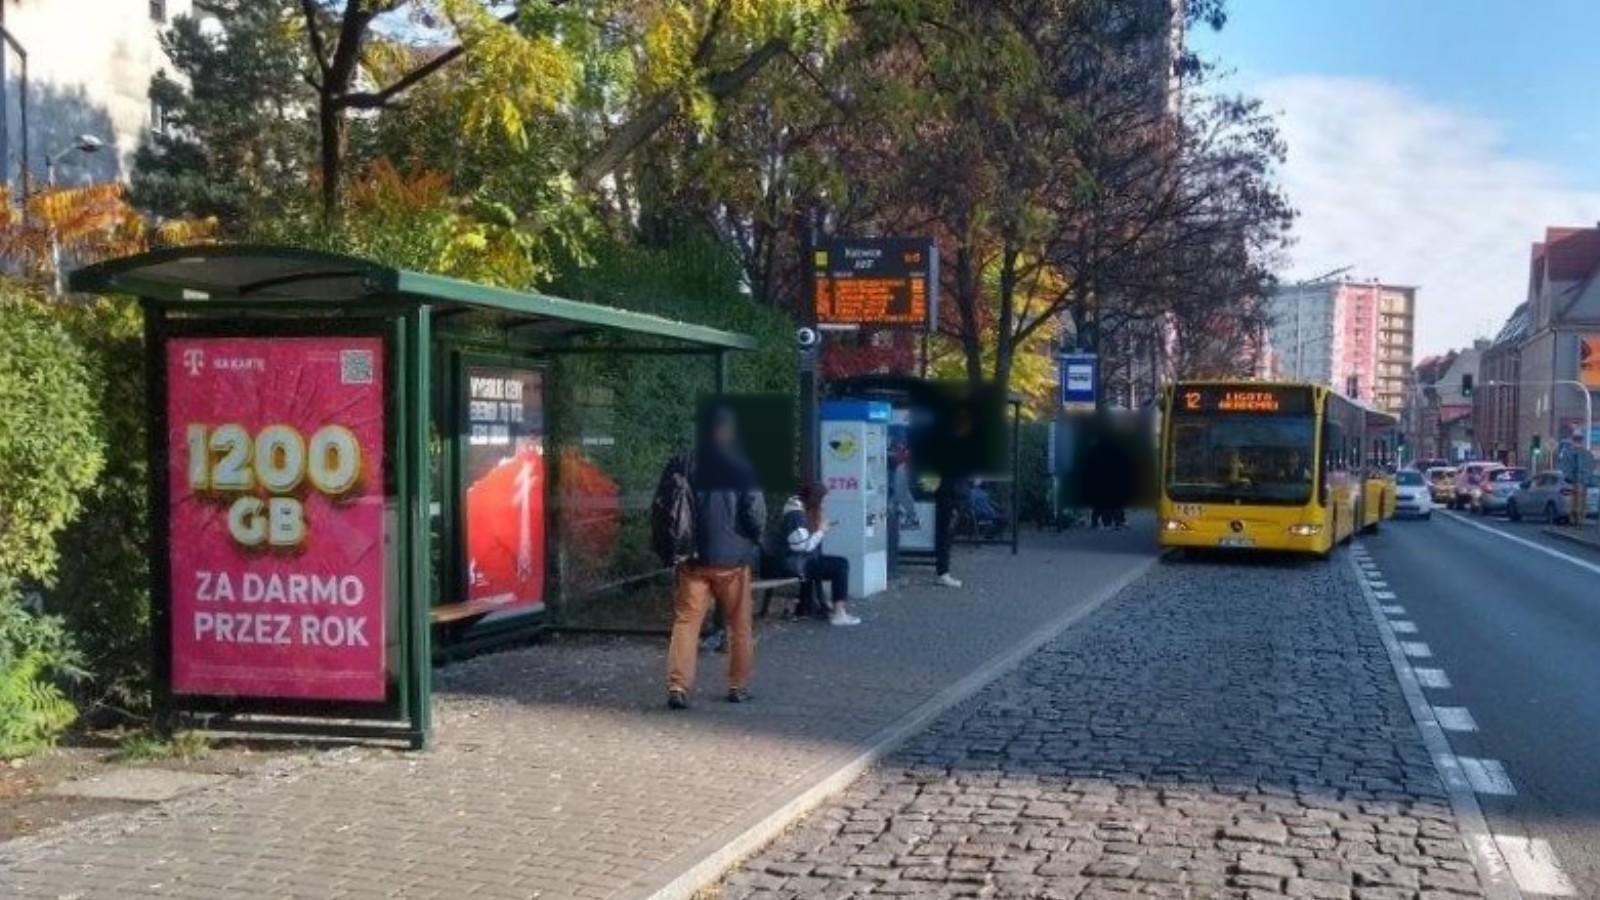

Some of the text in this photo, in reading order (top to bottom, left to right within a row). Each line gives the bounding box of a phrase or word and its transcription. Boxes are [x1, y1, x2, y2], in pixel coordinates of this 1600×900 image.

[1184, 391, 1201, 409] 12
[186, 423, 361, 494] 1200
[227, 496, 306, 547] GB
[195, 571, 365, 607] ZA DARMO
[194, 612, 369, 647] PRZEZ ROK
